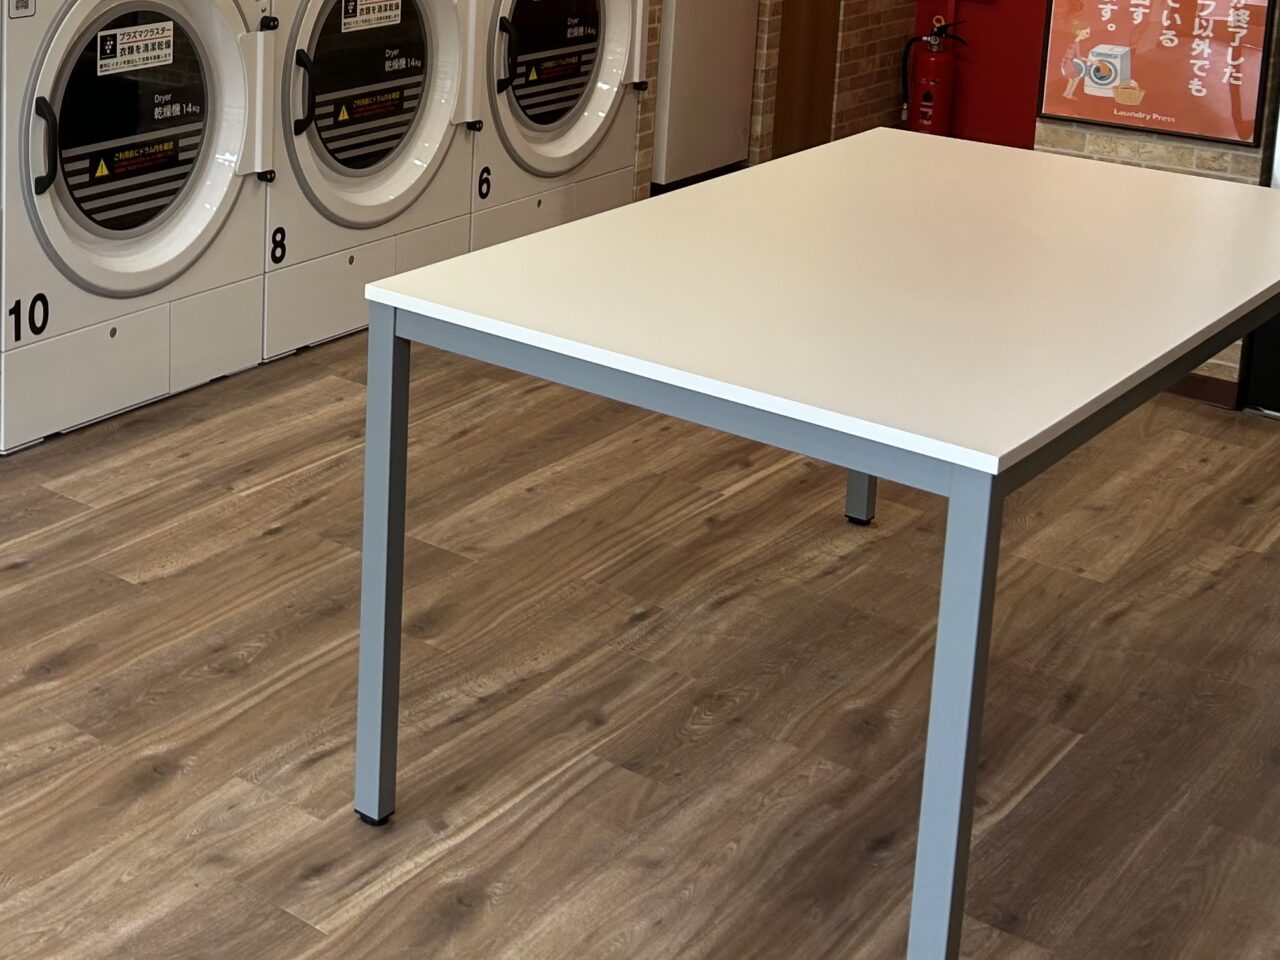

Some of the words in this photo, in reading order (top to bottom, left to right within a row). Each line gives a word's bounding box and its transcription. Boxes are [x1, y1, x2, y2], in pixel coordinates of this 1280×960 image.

[1113, 107, 1151, 121] Laundry
[1152, 112, 1176, 123] Press
[478, 166, 491, 199] 6
[270, 226, 286, 264] 8
[8, 293, 49, 342] 10
